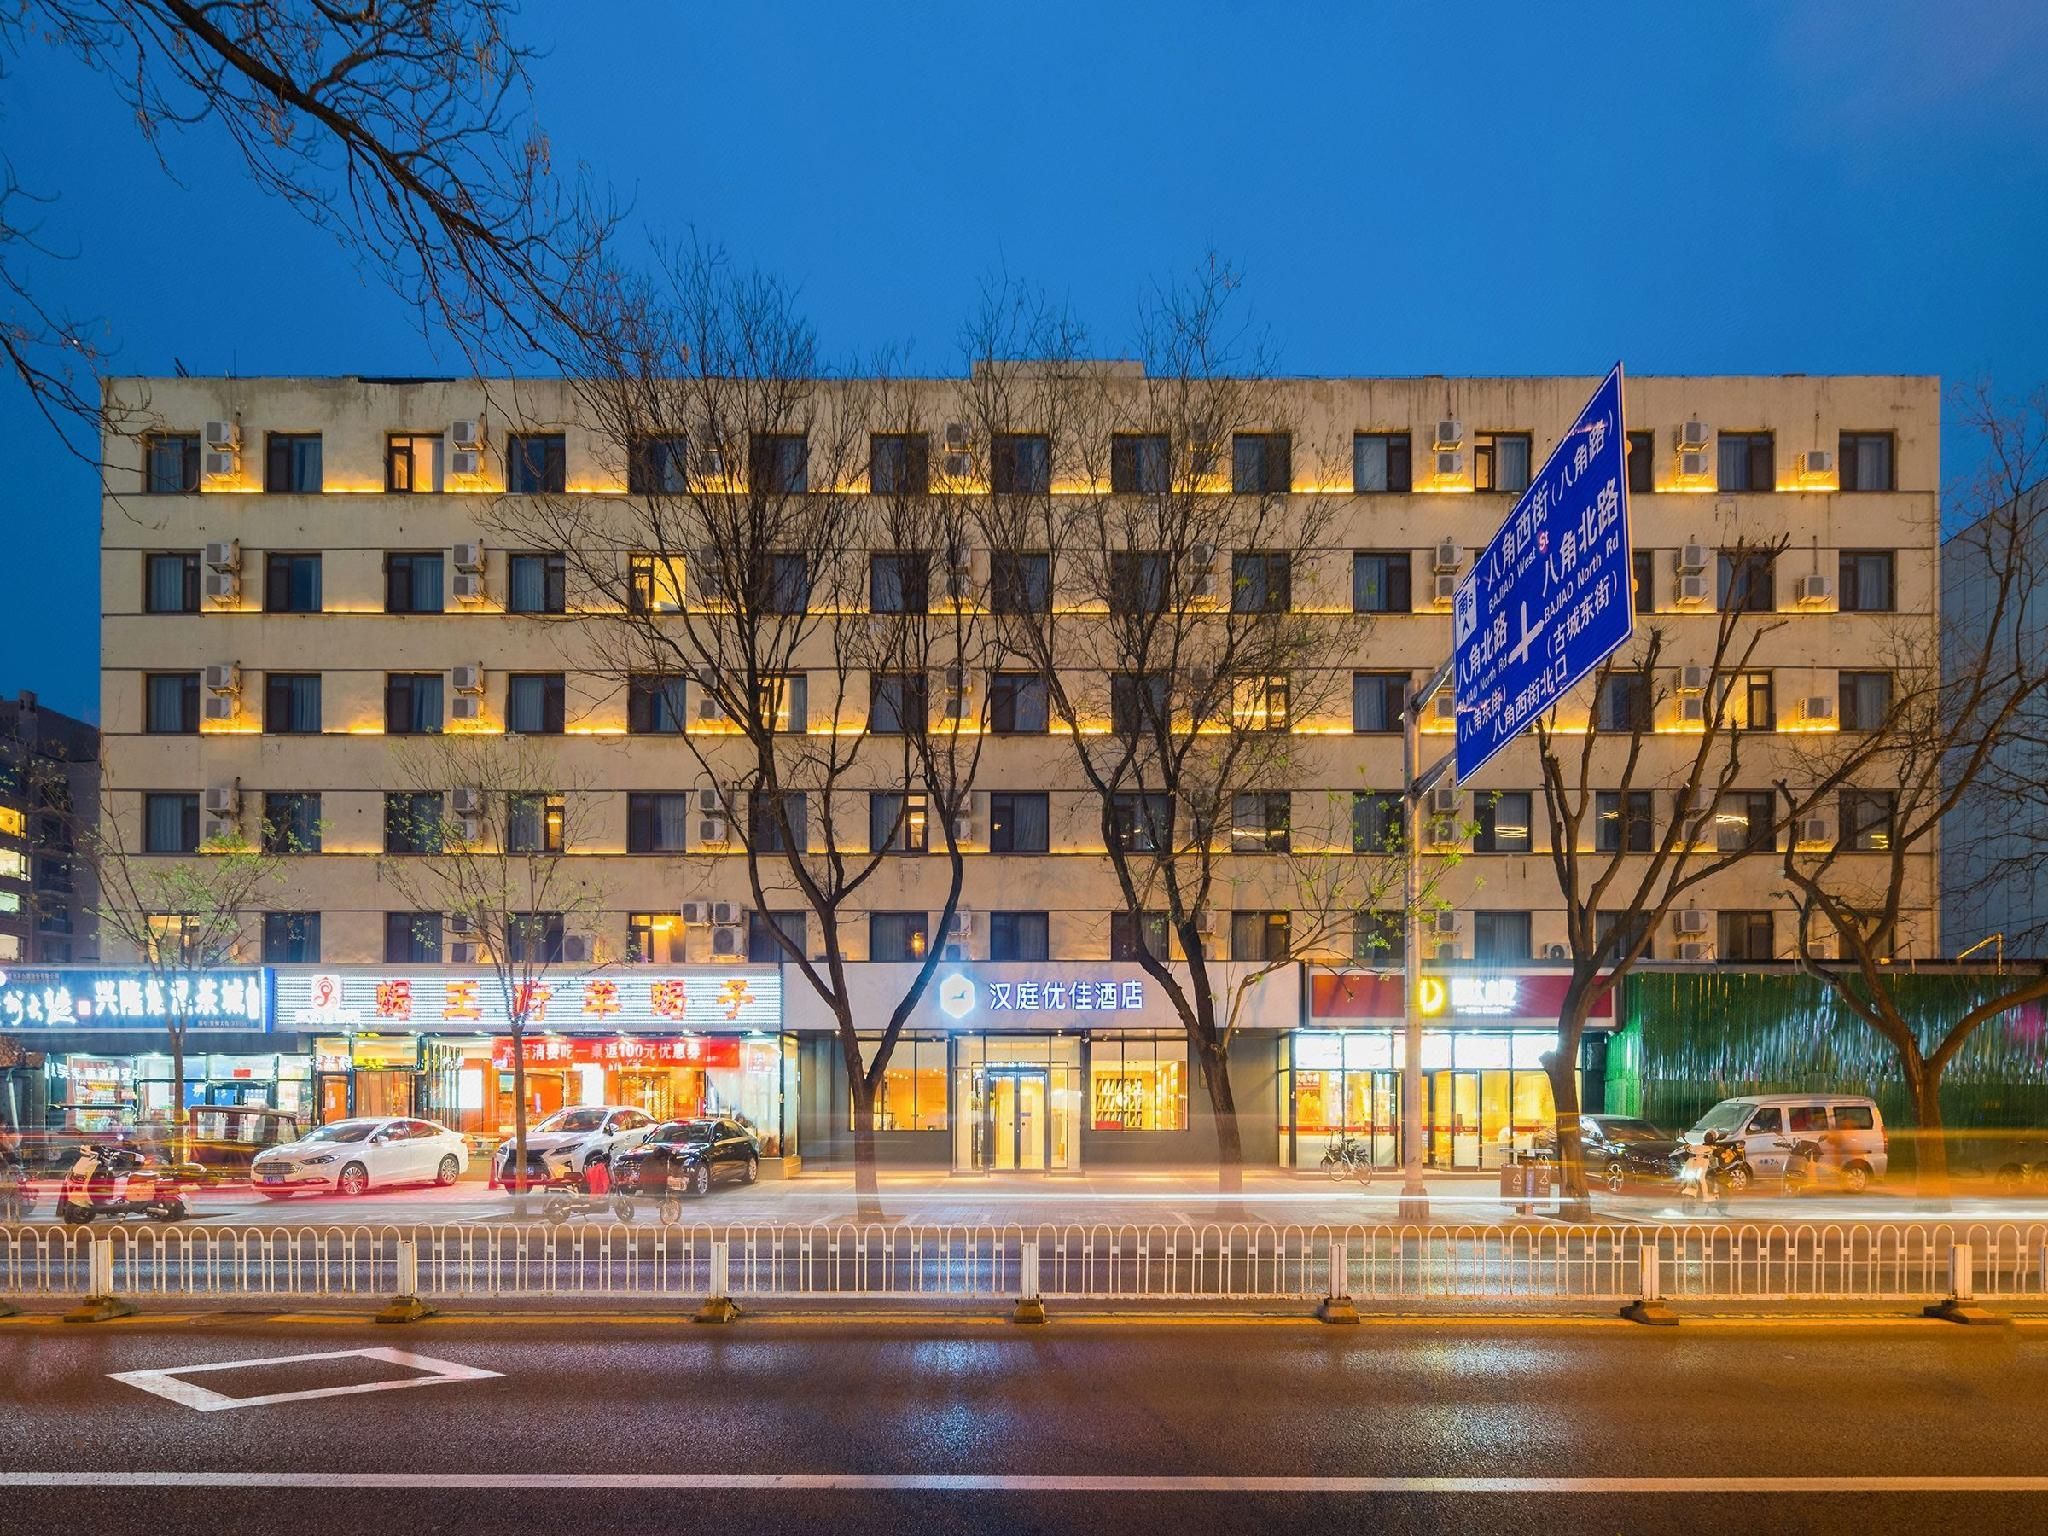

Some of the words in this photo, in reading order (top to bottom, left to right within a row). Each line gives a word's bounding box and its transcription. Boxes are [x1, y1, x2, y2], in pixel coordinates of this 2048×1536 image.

[1517, 546, 1536, 578] West
[1539, 530, 1549, 551] St
[1542, 477, 1619, 597] 八角北路
[1544, 580, 1574, 624] BAJIAO
[1577, 552, 1602, 590] North
[1606, 530, 1619, 558] Rd
[1457, 610, 1508, 693] 八角北路
[1492, 654, 1568, 743] 八角西街北口
[989, 980, 1143, 1010] 汉庭优佳酒店
